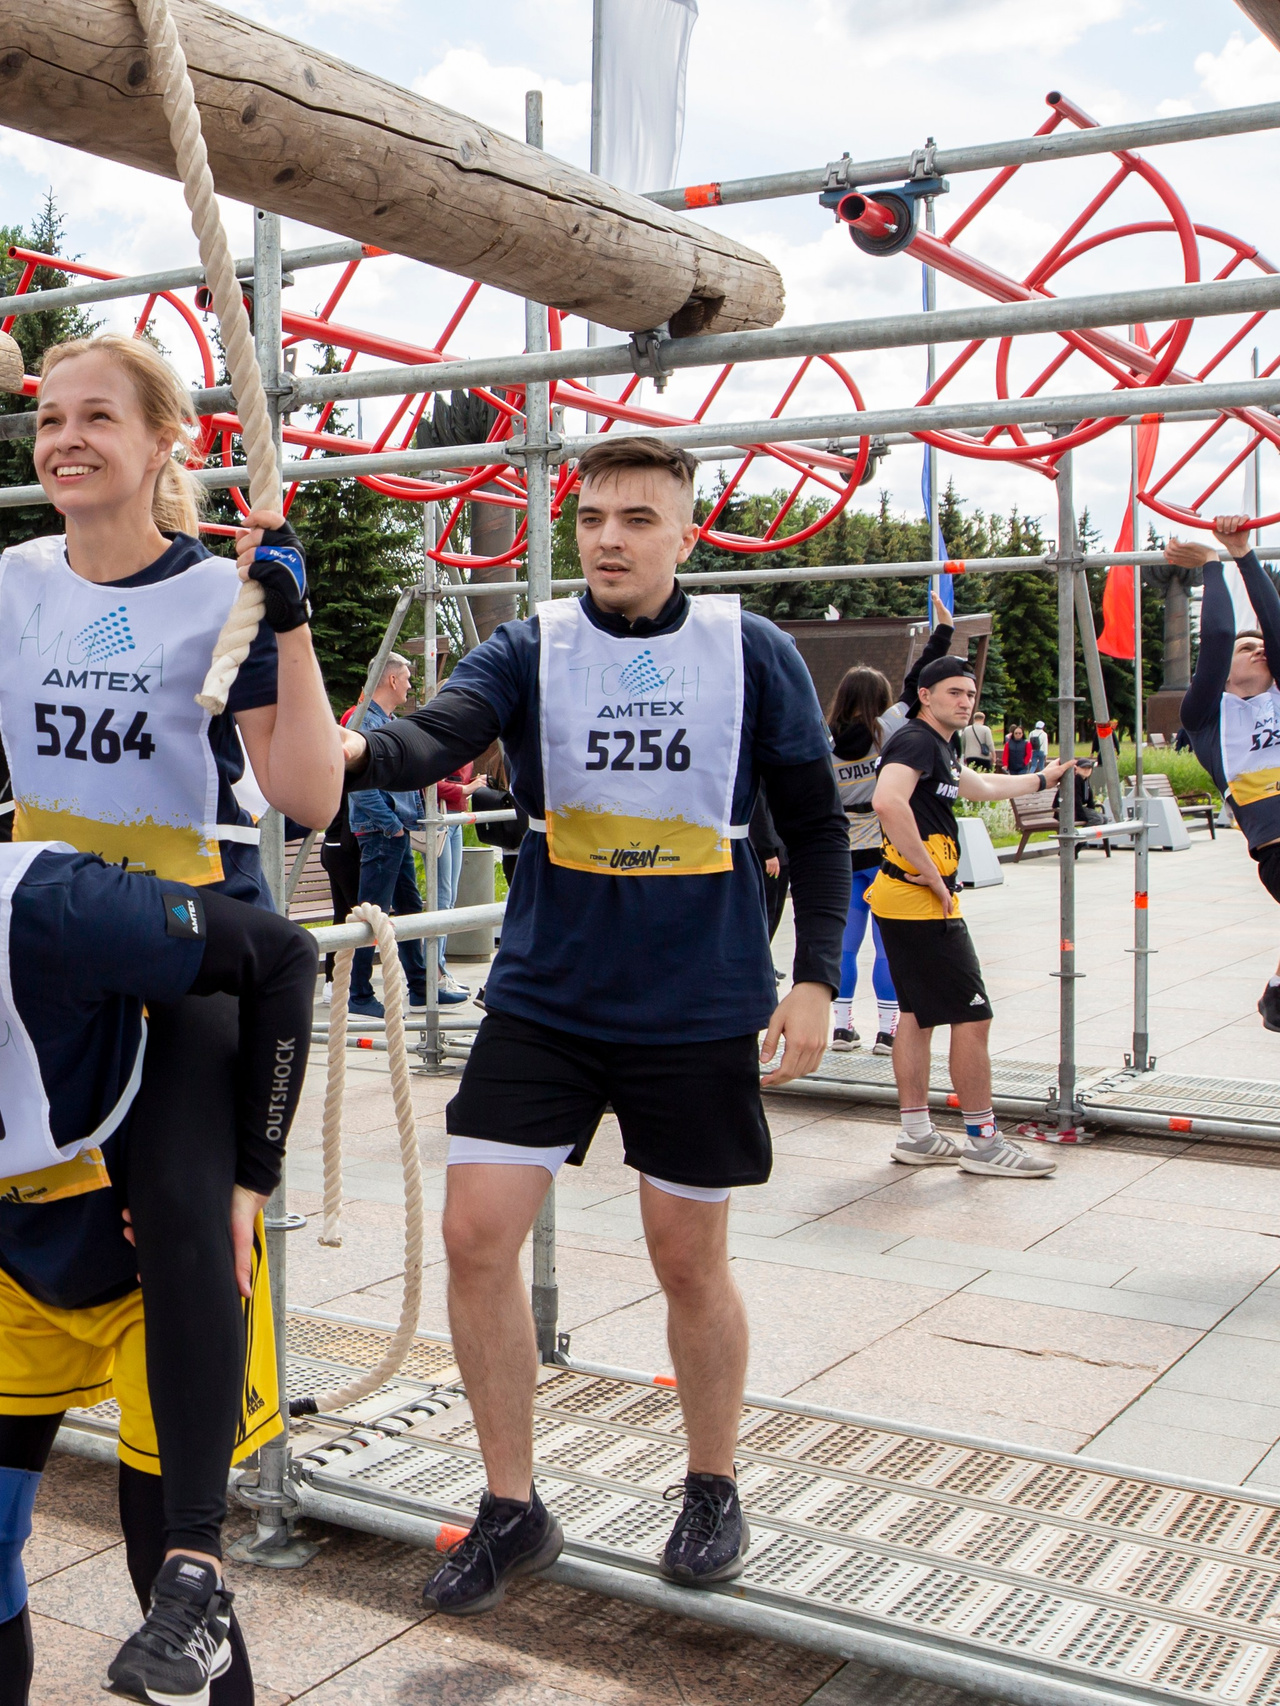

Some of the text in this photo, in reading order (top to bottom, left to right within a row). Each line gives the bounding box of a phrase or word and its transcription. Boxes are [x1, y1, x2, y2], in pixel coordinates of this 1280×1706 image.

[41, 668, 151, 694] AMTEX
[597, 700, 684, 719] AMTEX
[34, 702, 156, 764] 5264
[585, 728, 691, 772] 5256
[609, 844, 660, 871] URBAN
[186, 899, 199, 934] AMTEX
[266, 1036, 296, 1141] OUTSHOCK
